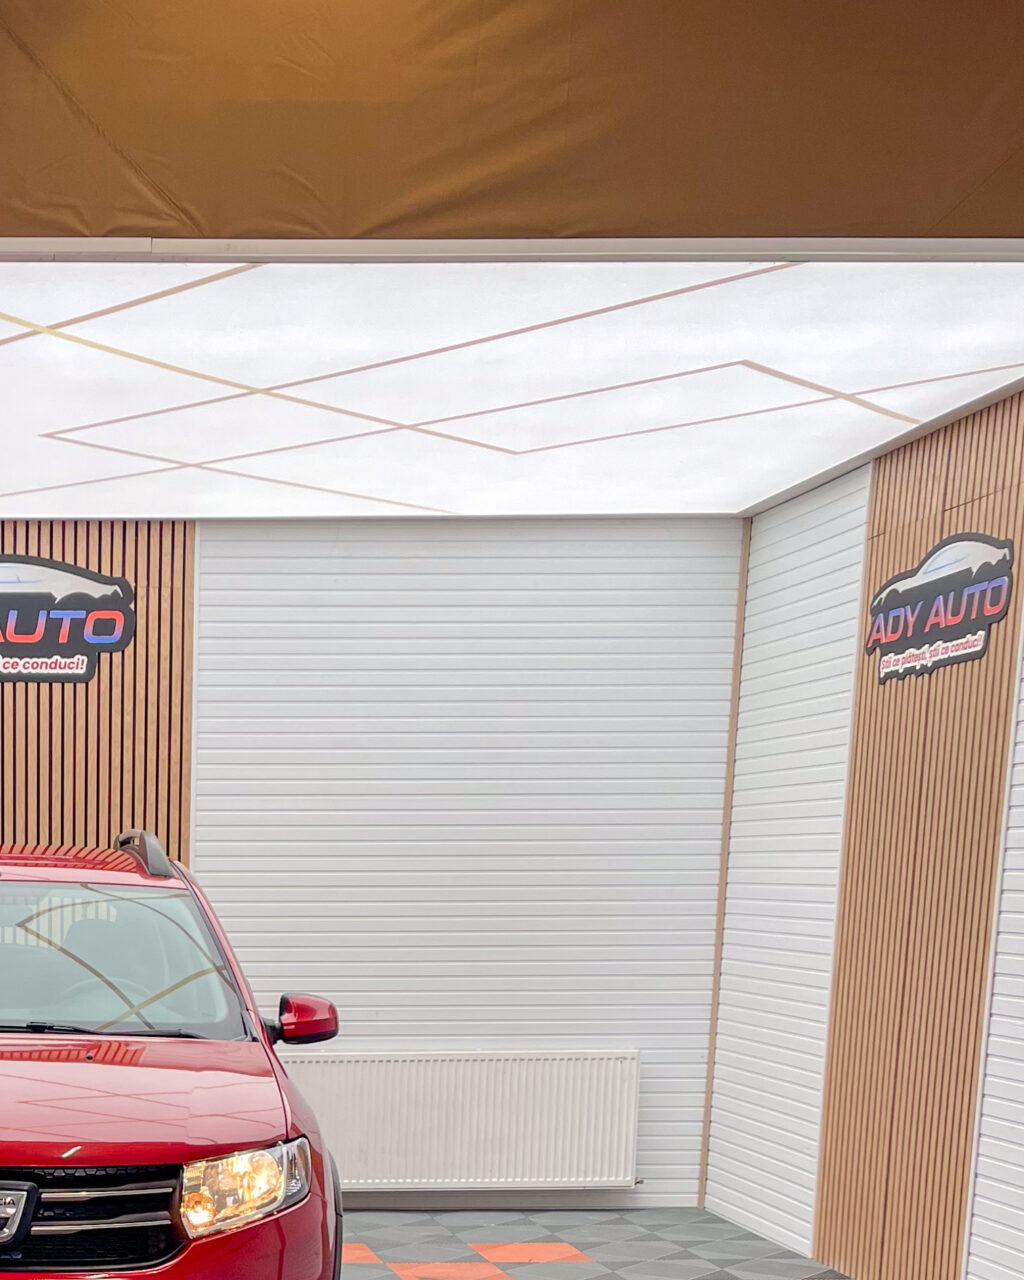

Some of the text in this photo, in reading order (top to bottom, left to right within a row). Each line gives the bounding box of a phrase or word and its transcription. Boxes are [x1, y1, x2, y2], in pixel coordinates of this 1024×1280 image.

[866, 576, 1009, 649] ADY AUTO
[2, 660, 19, 670] ce
[22, 658, 85, 670] conduci!
